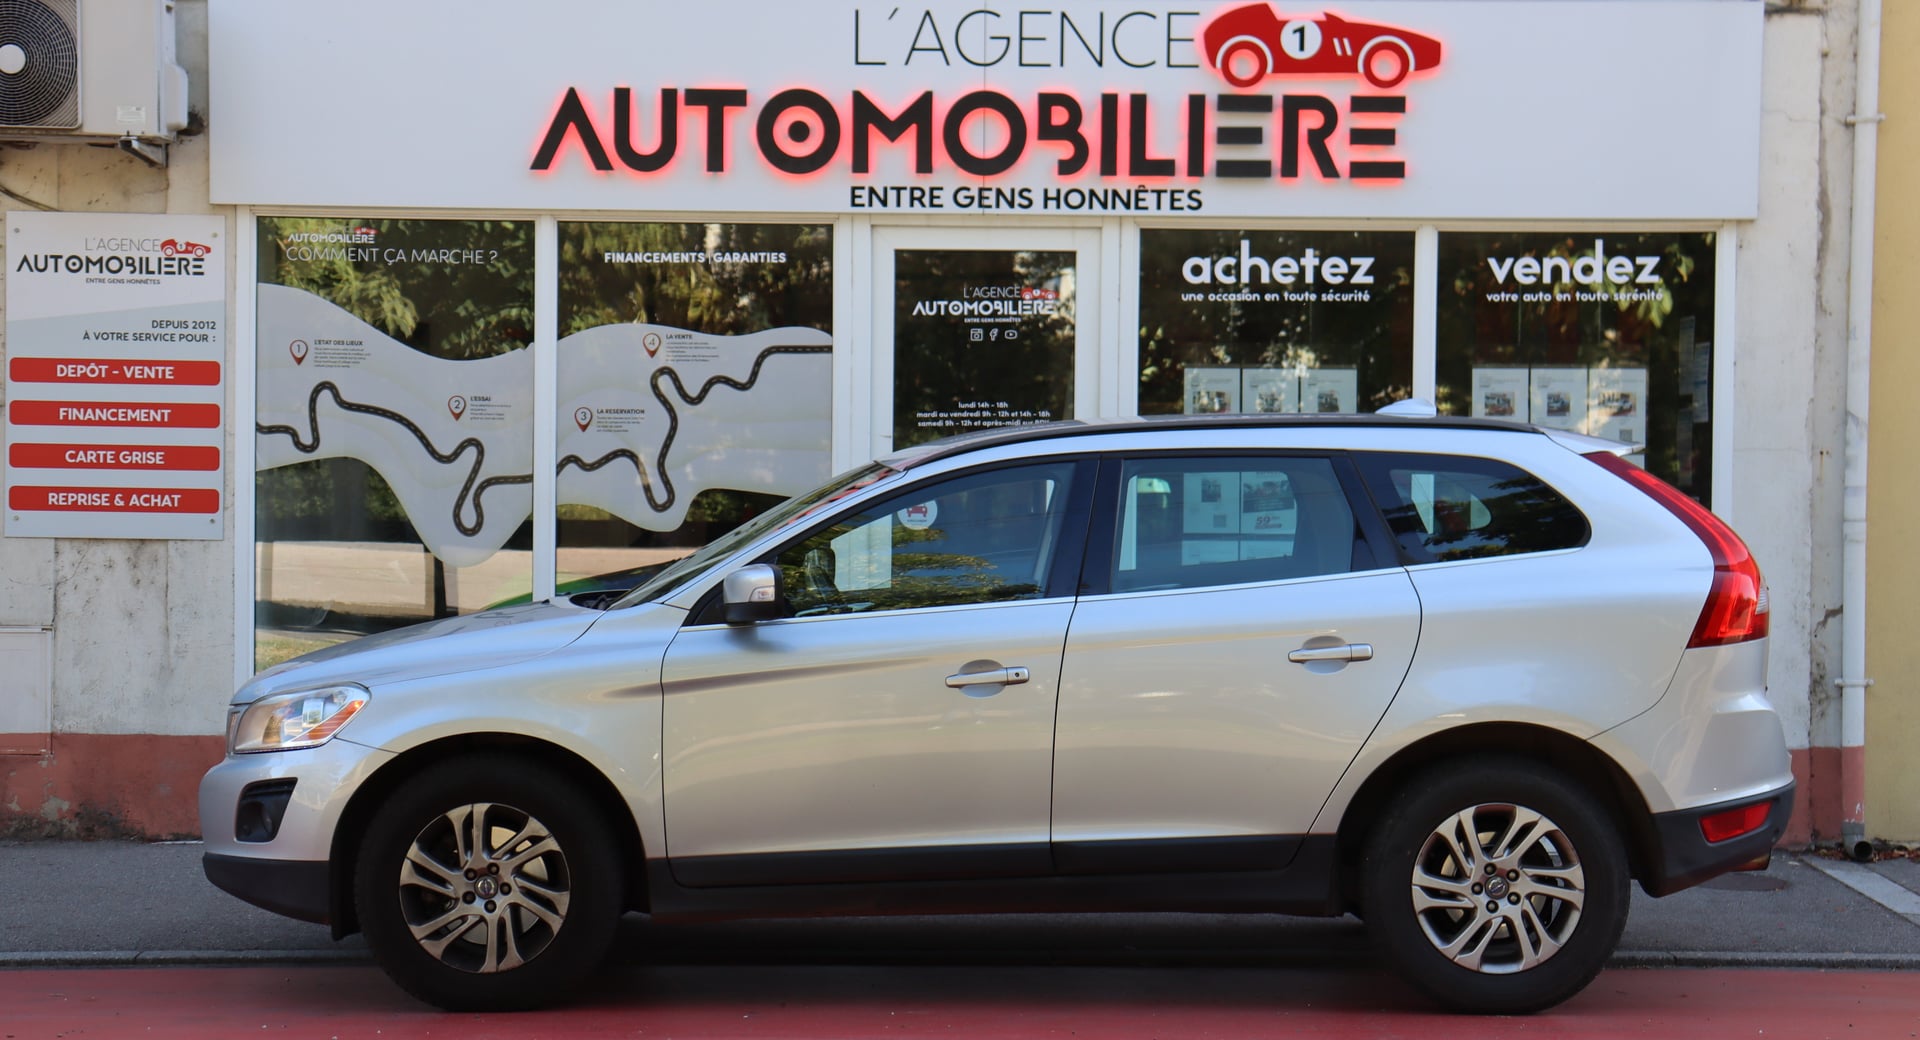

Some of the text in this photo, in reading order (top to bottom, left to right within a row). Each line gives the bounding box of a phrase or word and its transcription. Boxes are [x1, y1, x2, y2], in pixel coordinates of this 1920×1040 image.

[853, 7, 1200, 68] L'AGENCE
[1292, 25, 1305, 52] 1
[850, 185, 1203, 211] ENTRE GENS HONNÊTES
[85, 238, 161, 252] L'AGENCE
[286, 246, 498, 266] COMMENT ÇA MARCHE ?
[604, 252, 705, 264] FINANCEMENTS
[713, 252, 786, 264] GARANTIES
[1182, 239, 1375, 285] achetez
[1487, 239, 1660, 284] vendez
[963, 287, 1020, 298] L'AGENCE
[1181, 289, 1370, 302] une occasion en toute sécurité
[1486, 291, 1518, 302] votre
[1523, 291, 1552, 302] auto
[1556, 292, 1571, 301] en
[1575, 290, 1608, 301] toute
[151, 320, 216, 330] DEPUIS 2012
[83, 330, 90, 340] À
[93, 332, 129, 341] VOTRE
[132, 332, 176, 342] SERVICE
[178, 333, 208, 342] POUR
[649, 338, 655, 346] 4
[56, 362, 108, 378] DEPÔT
[123, 366, 174, 379] VENTE
[454, 400, 461, 409] 2
[59, 407, 171, 422] FINANCEMENT
[580, 411, 587, 420] 3
[982, 419, 1020, 428] après-midi
[65, 450, 165, 465] CARTE GRISE
[48, 492, 181, 508] REPRISE & ACHAT
